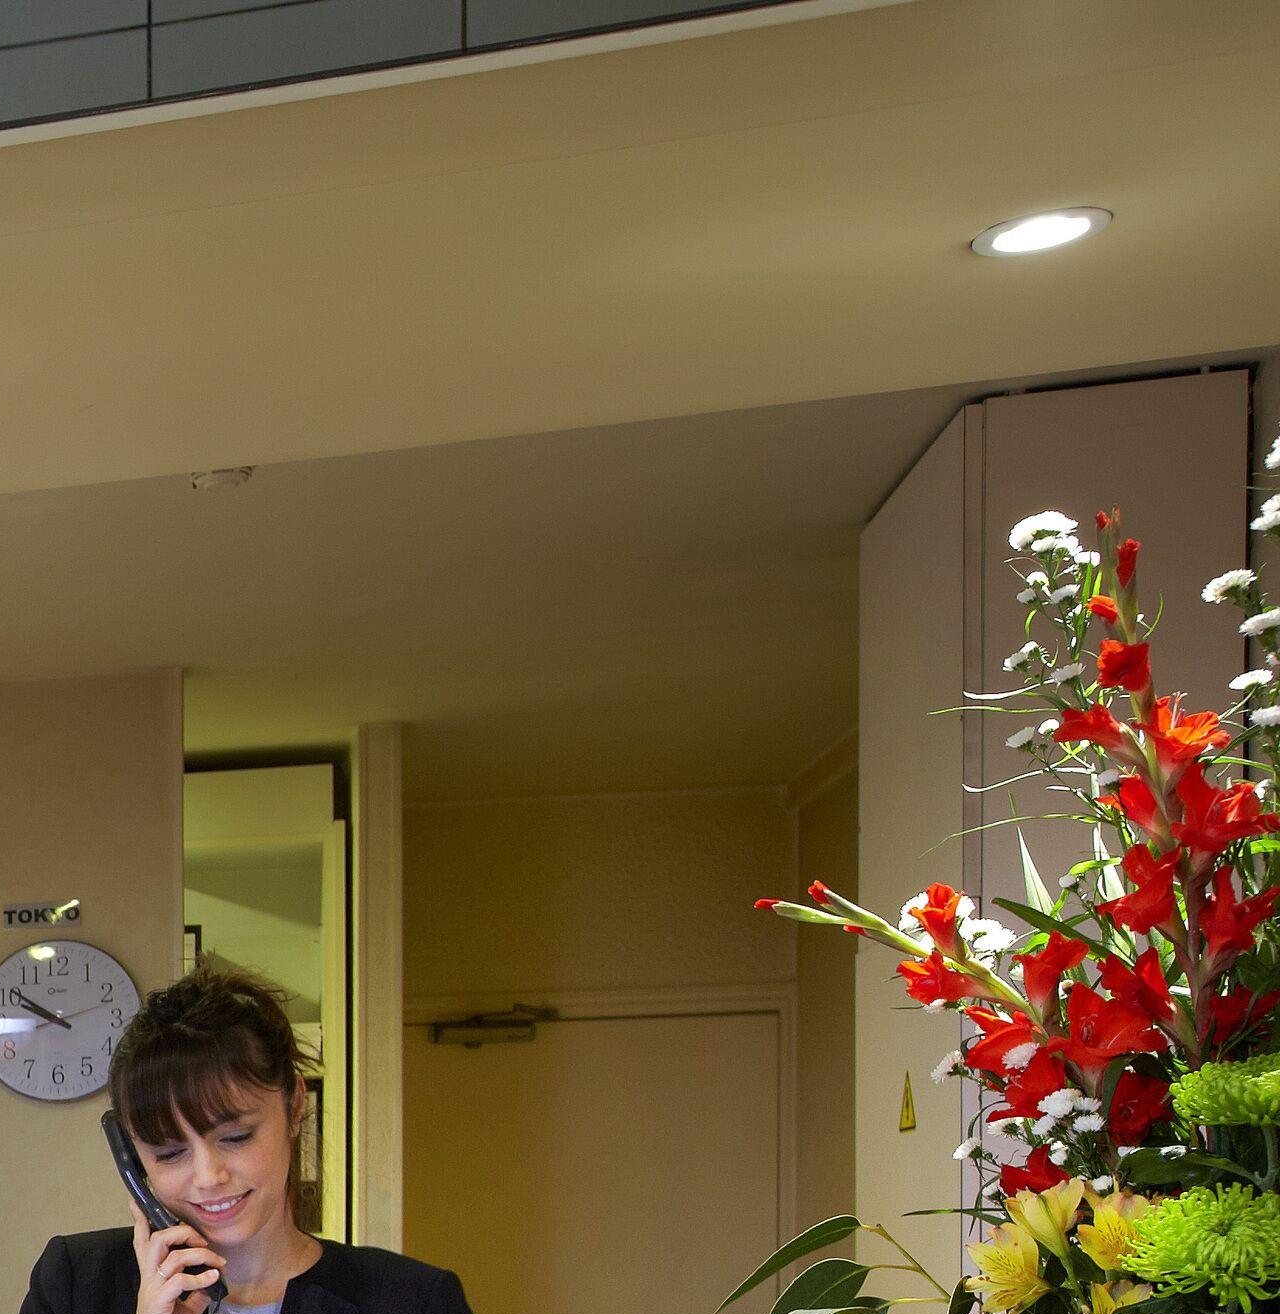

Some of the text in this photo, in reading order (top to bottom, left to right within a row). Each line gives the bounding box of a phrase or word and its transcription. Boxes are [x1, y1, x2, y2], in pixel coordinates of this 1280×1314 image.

[20, 965, 40, 985] 11
[47, 956, 70, 977] 12
[83, 963, 91, 982] 1
[0, 986, 22, 1007] 10
[100, 983, 114, 1003] 2
[111, 1008, 123, 1028] 3
[3, 1039, 16, 1060] 8
[101, 1036, 113, 1056] 4
[24, 1059, 35, 1079] 7
[52, 1064, 65, 1085] 6
[80, 1056, 93, 1077] 5
